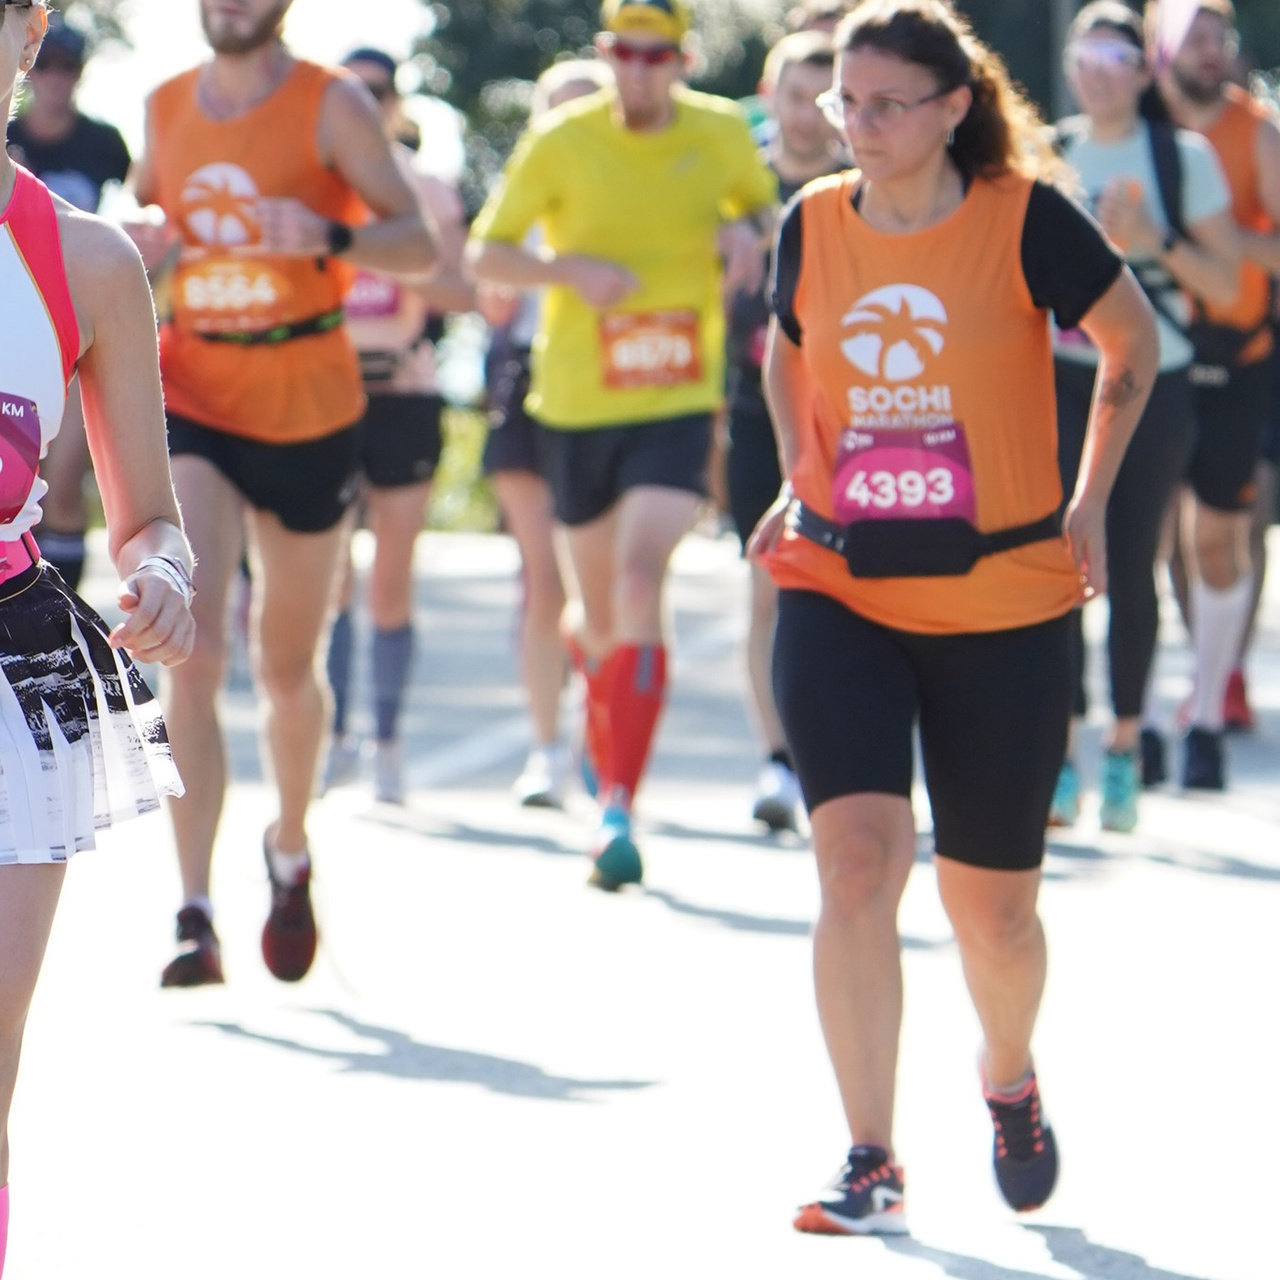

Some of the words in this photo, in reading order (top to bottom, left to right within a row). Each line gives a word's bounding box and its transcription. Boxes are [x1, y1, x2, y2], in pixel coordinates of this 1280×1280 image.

[2, 402, 25, 418] KM
[847, 384, 952, 413] SOCHI
[849, 413, 955, 430] MARATHON
[844, 467, 955, 508] 4393
